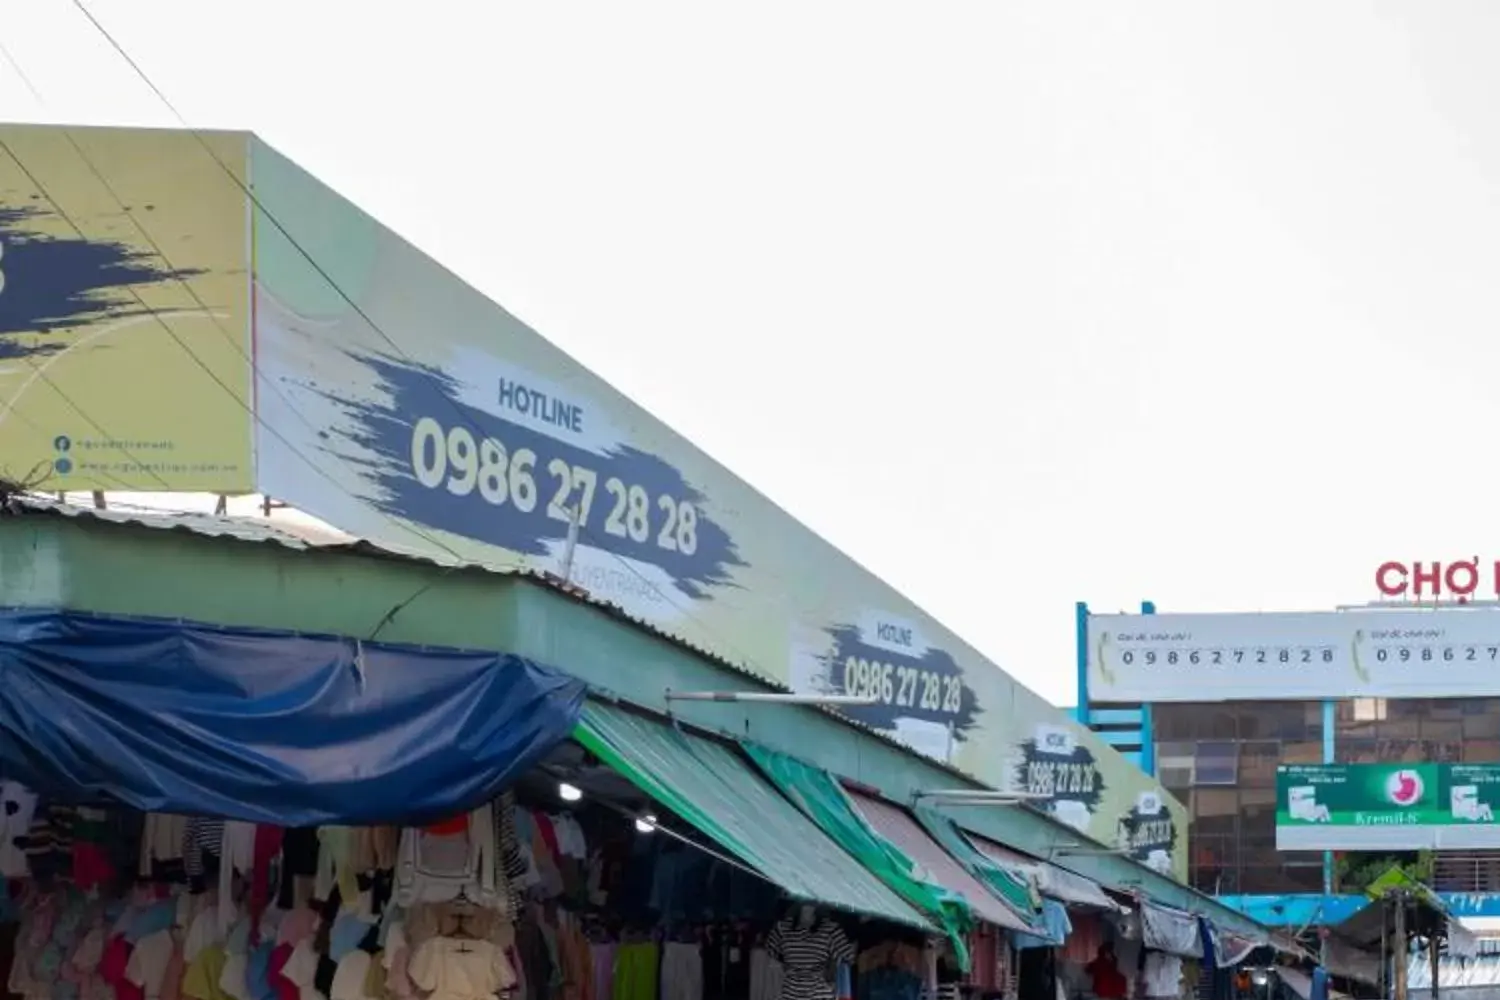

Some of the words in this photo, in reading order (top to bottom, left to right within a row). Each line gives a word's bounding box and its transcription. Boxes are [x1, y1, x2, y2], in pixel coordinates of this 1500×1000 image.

[498, 377, 584, 433] HOTLINE
[411, 416, 537, 513] 0986
[546, 458, 597, 527] 27
[604, 476, 649, 543] 28
[657, 493, 697, 555] 28
[1375, 555, 1479, 604] CHỢ
[896, 665, 917, 708] 27
[919, 671, 940, 711] 28
